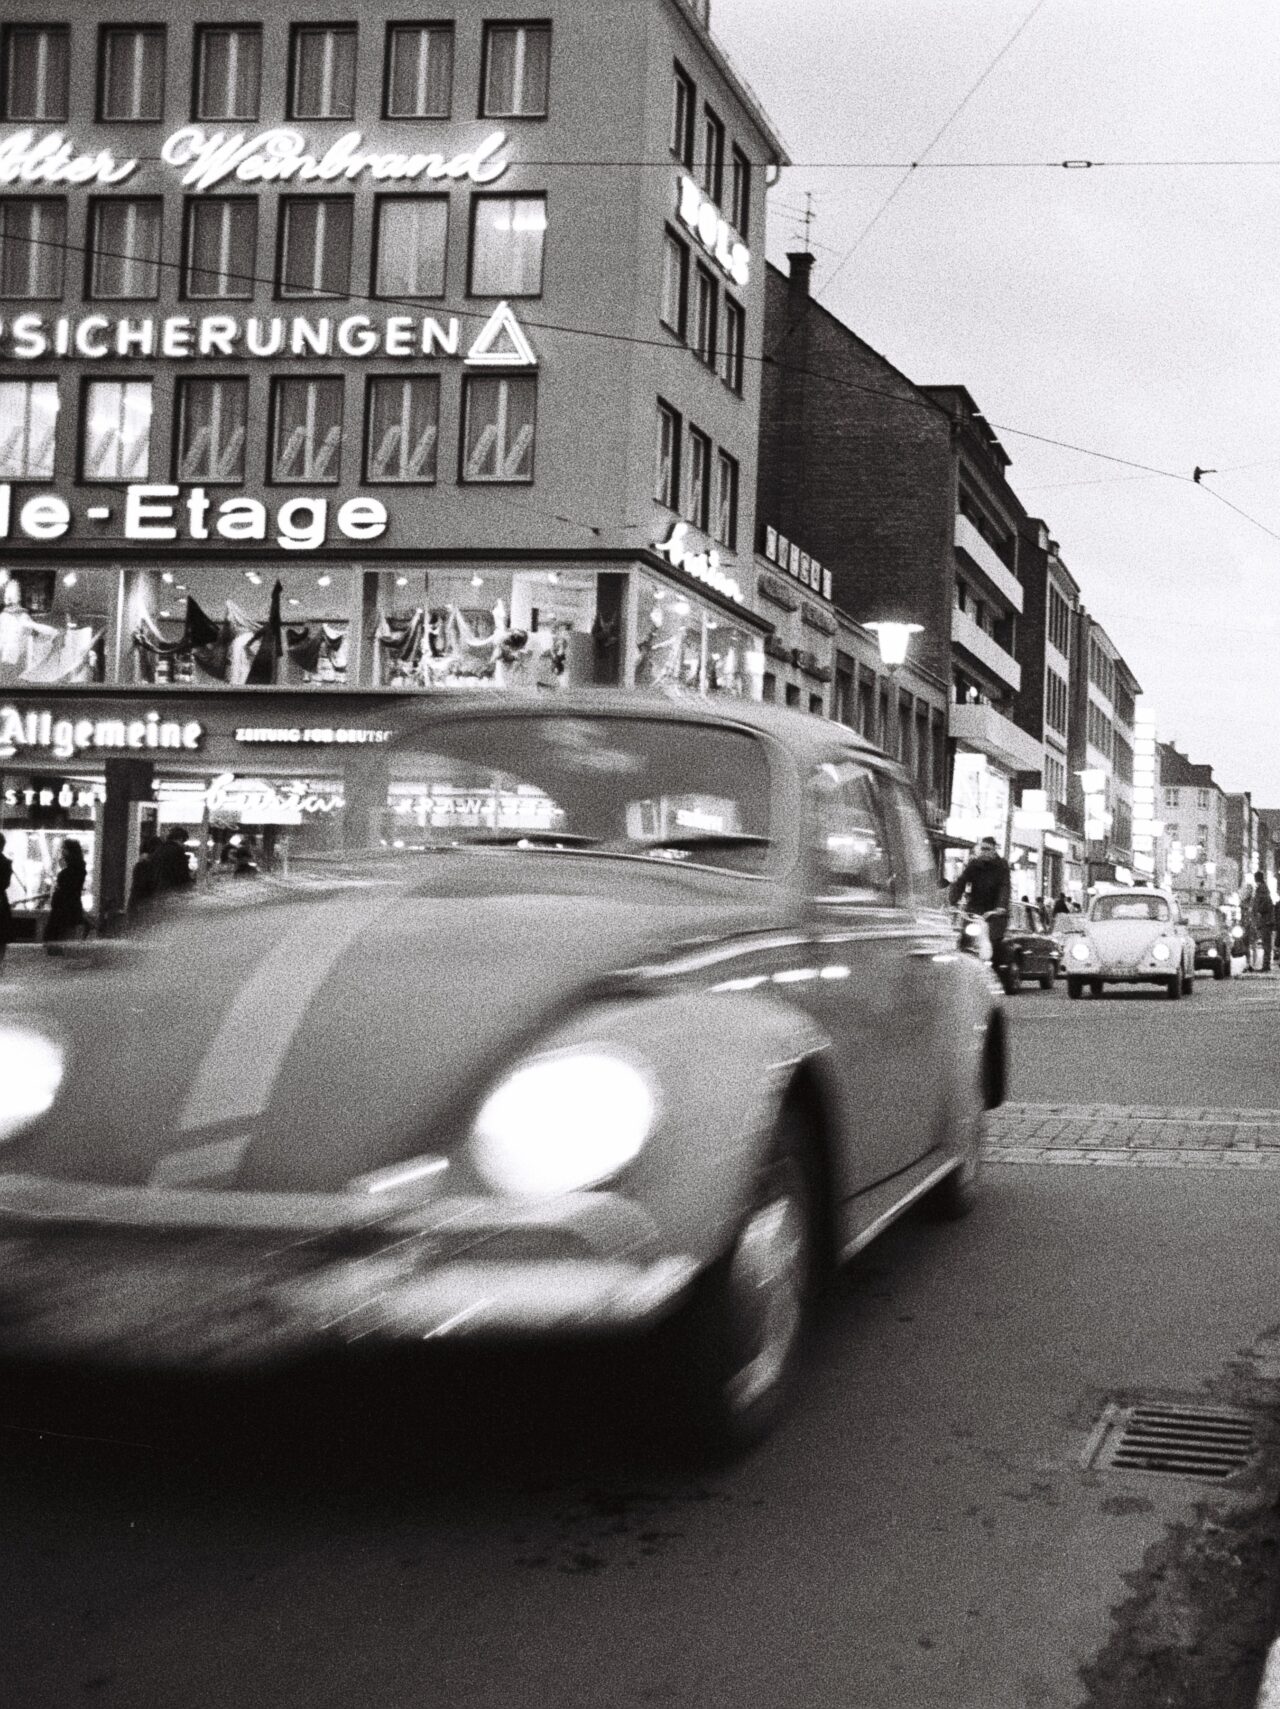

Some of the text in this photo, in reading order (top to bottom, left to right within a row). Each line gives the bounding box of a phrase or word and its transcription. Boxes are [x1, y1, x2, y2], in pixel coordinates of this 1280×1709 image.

[160, 128, 507, 191] Weinbrand
[0, 315, 460, 358] SICHERUNGEN
[0, 706, 202, 757] Allgemeine
